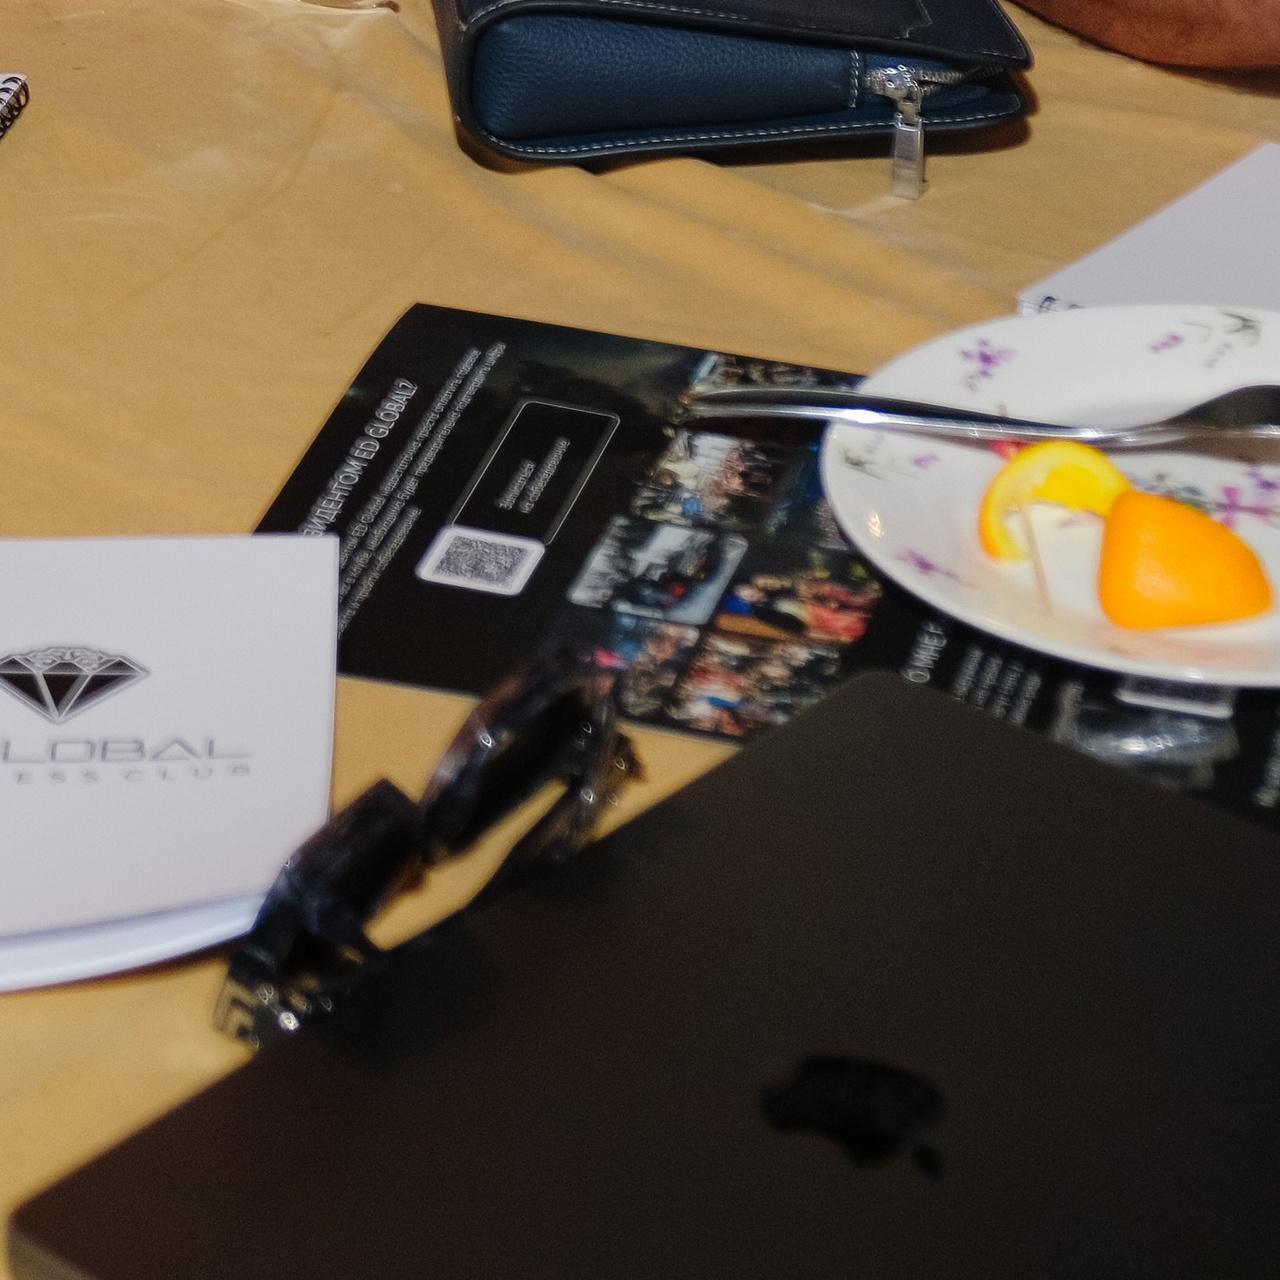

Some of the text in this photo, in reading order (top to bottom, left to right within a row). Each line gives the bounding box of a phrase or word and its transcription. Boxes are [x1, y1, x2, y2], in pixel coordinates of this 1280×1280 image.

[301, 377, 419, 536] ЗИДЕНТОМ ED GLOBAL?
[123, 762, 251, 782] CLUB
